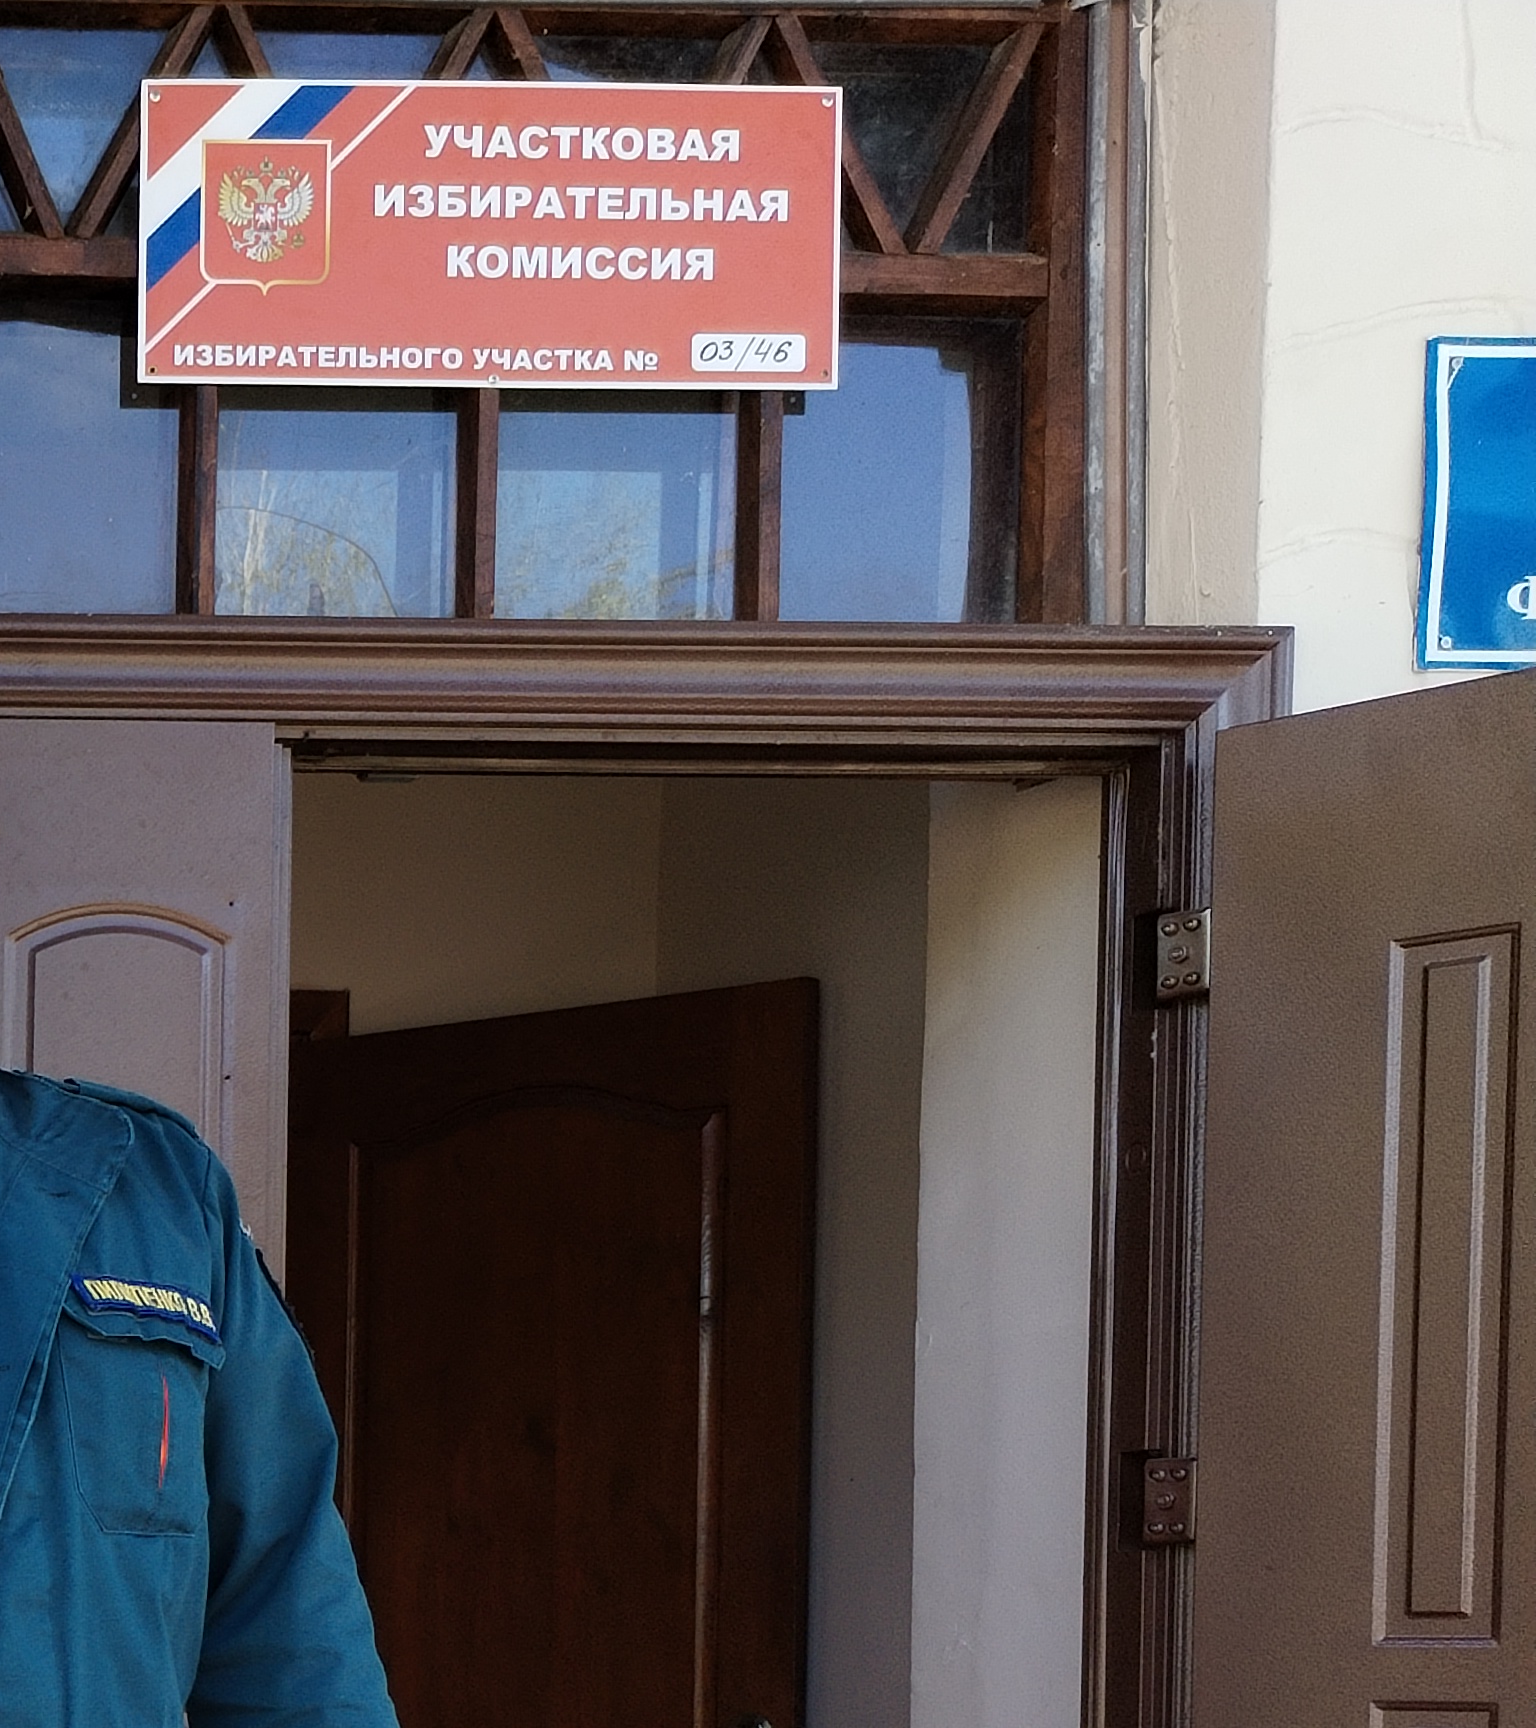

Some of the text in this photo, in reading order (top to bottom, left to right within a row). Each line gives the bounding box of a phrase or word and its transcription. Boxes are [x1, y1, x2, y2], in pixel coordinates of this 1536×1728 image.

[424, 125, 740, 162] УЧАСТКОВАЯ
[373, 185, 788, 223] ИЗБИРАТЕЛЬНАЯ
[447, 245, 714, 282] КОМИССИЯ
[174, 345, 463, 371] ИЗБИРАТЕЛЬНОГО
[474, 348, 613, 372] УЧАСТКА
[700, 338, 792, 369] 03/46
